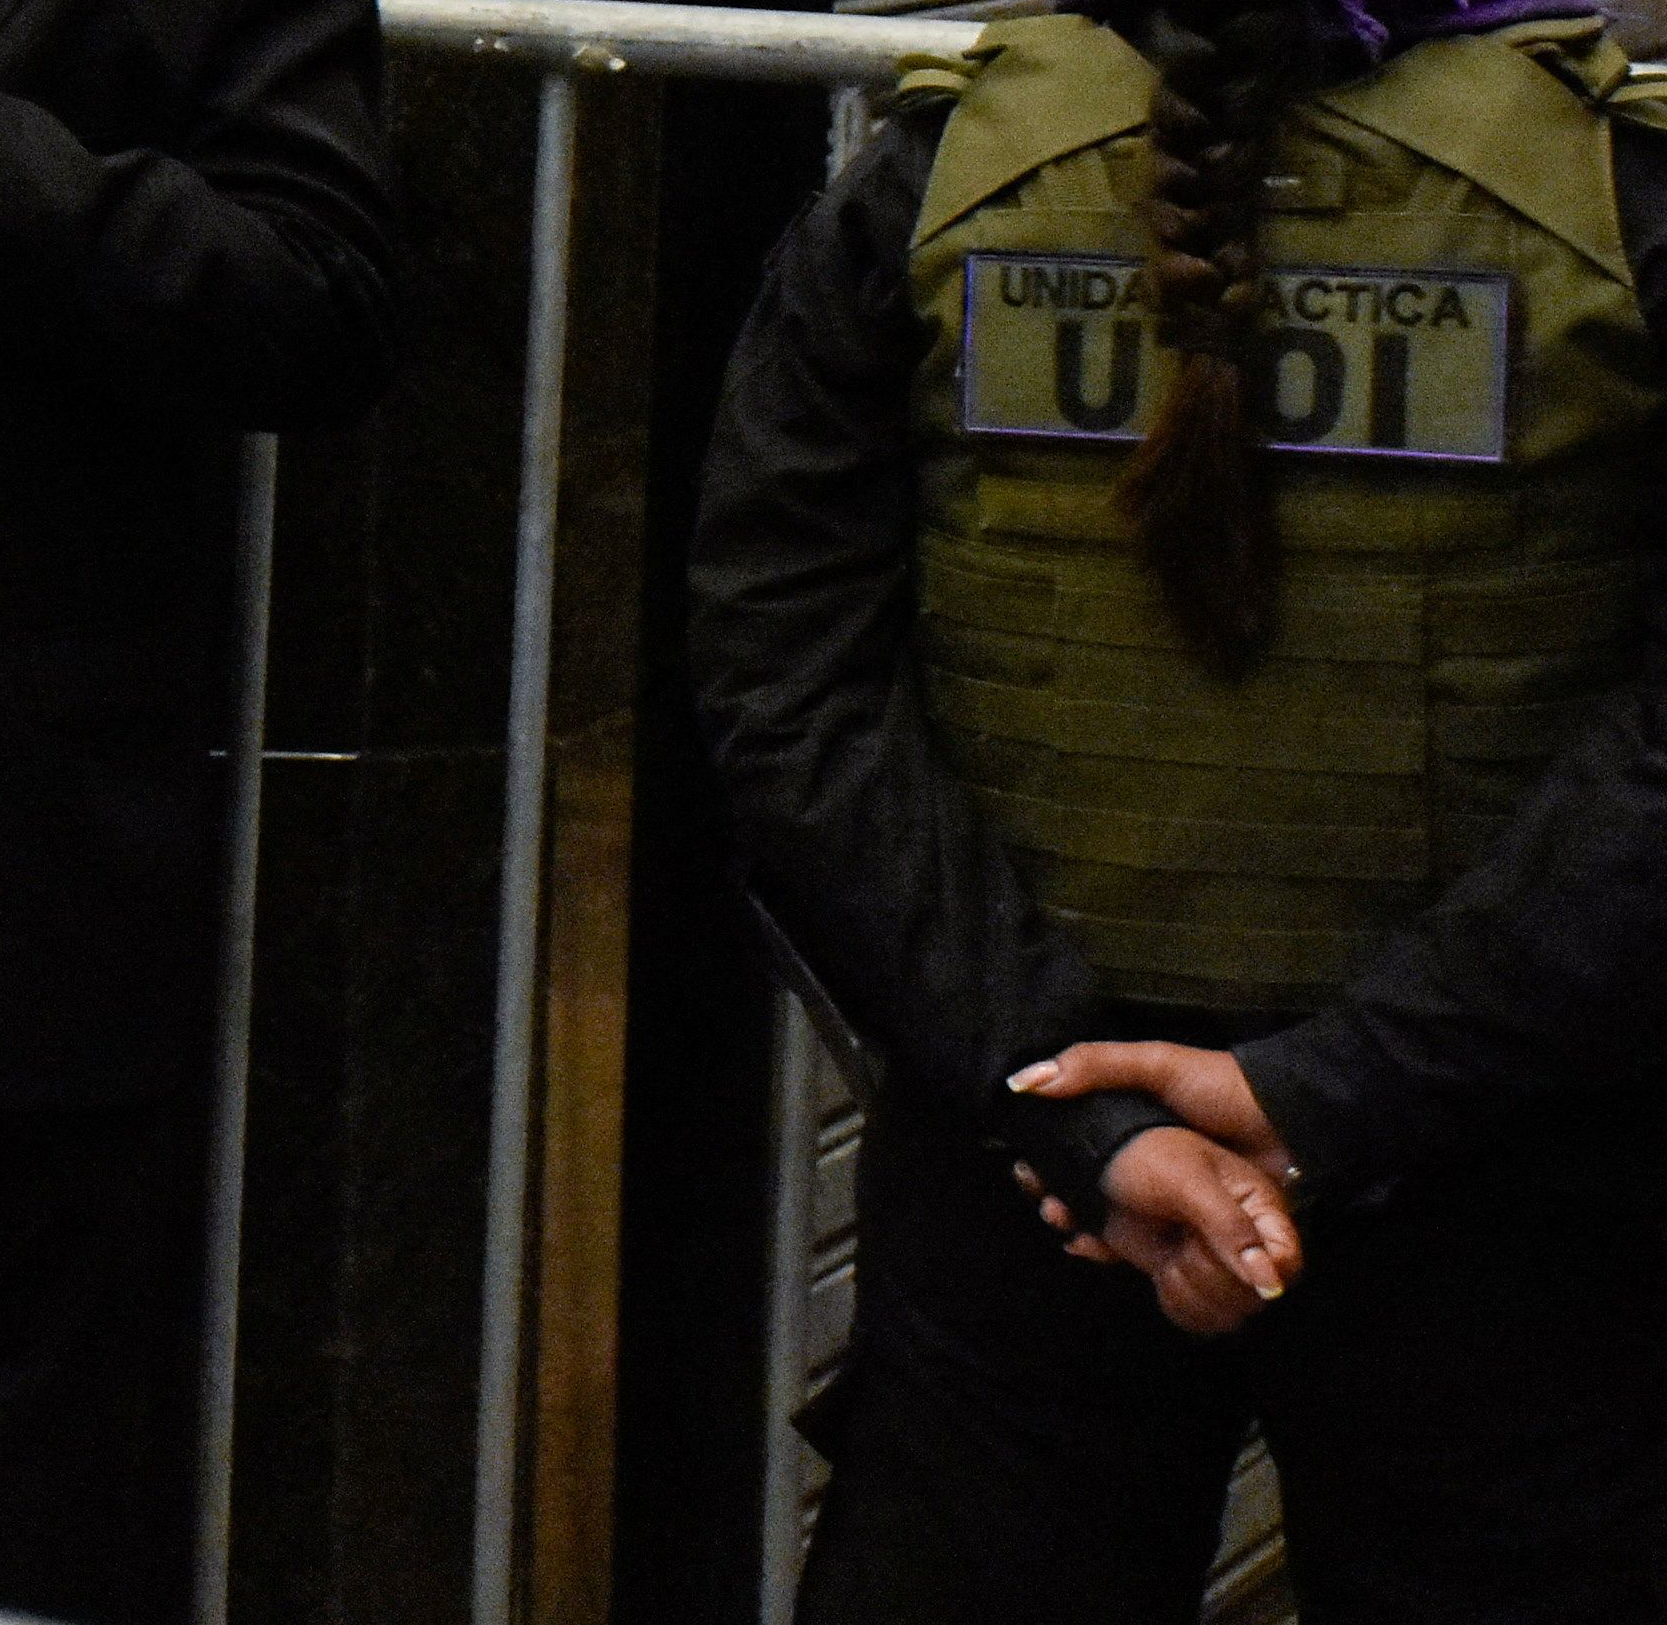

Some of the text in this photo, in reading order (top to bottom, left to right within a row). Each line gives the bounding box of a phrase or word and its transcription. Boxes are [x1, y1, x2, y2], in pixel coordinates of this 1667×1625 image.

[1000, 264, 1470, 327] UNIDA ACTICA
[1054, 319, 1409, 447] UOI
